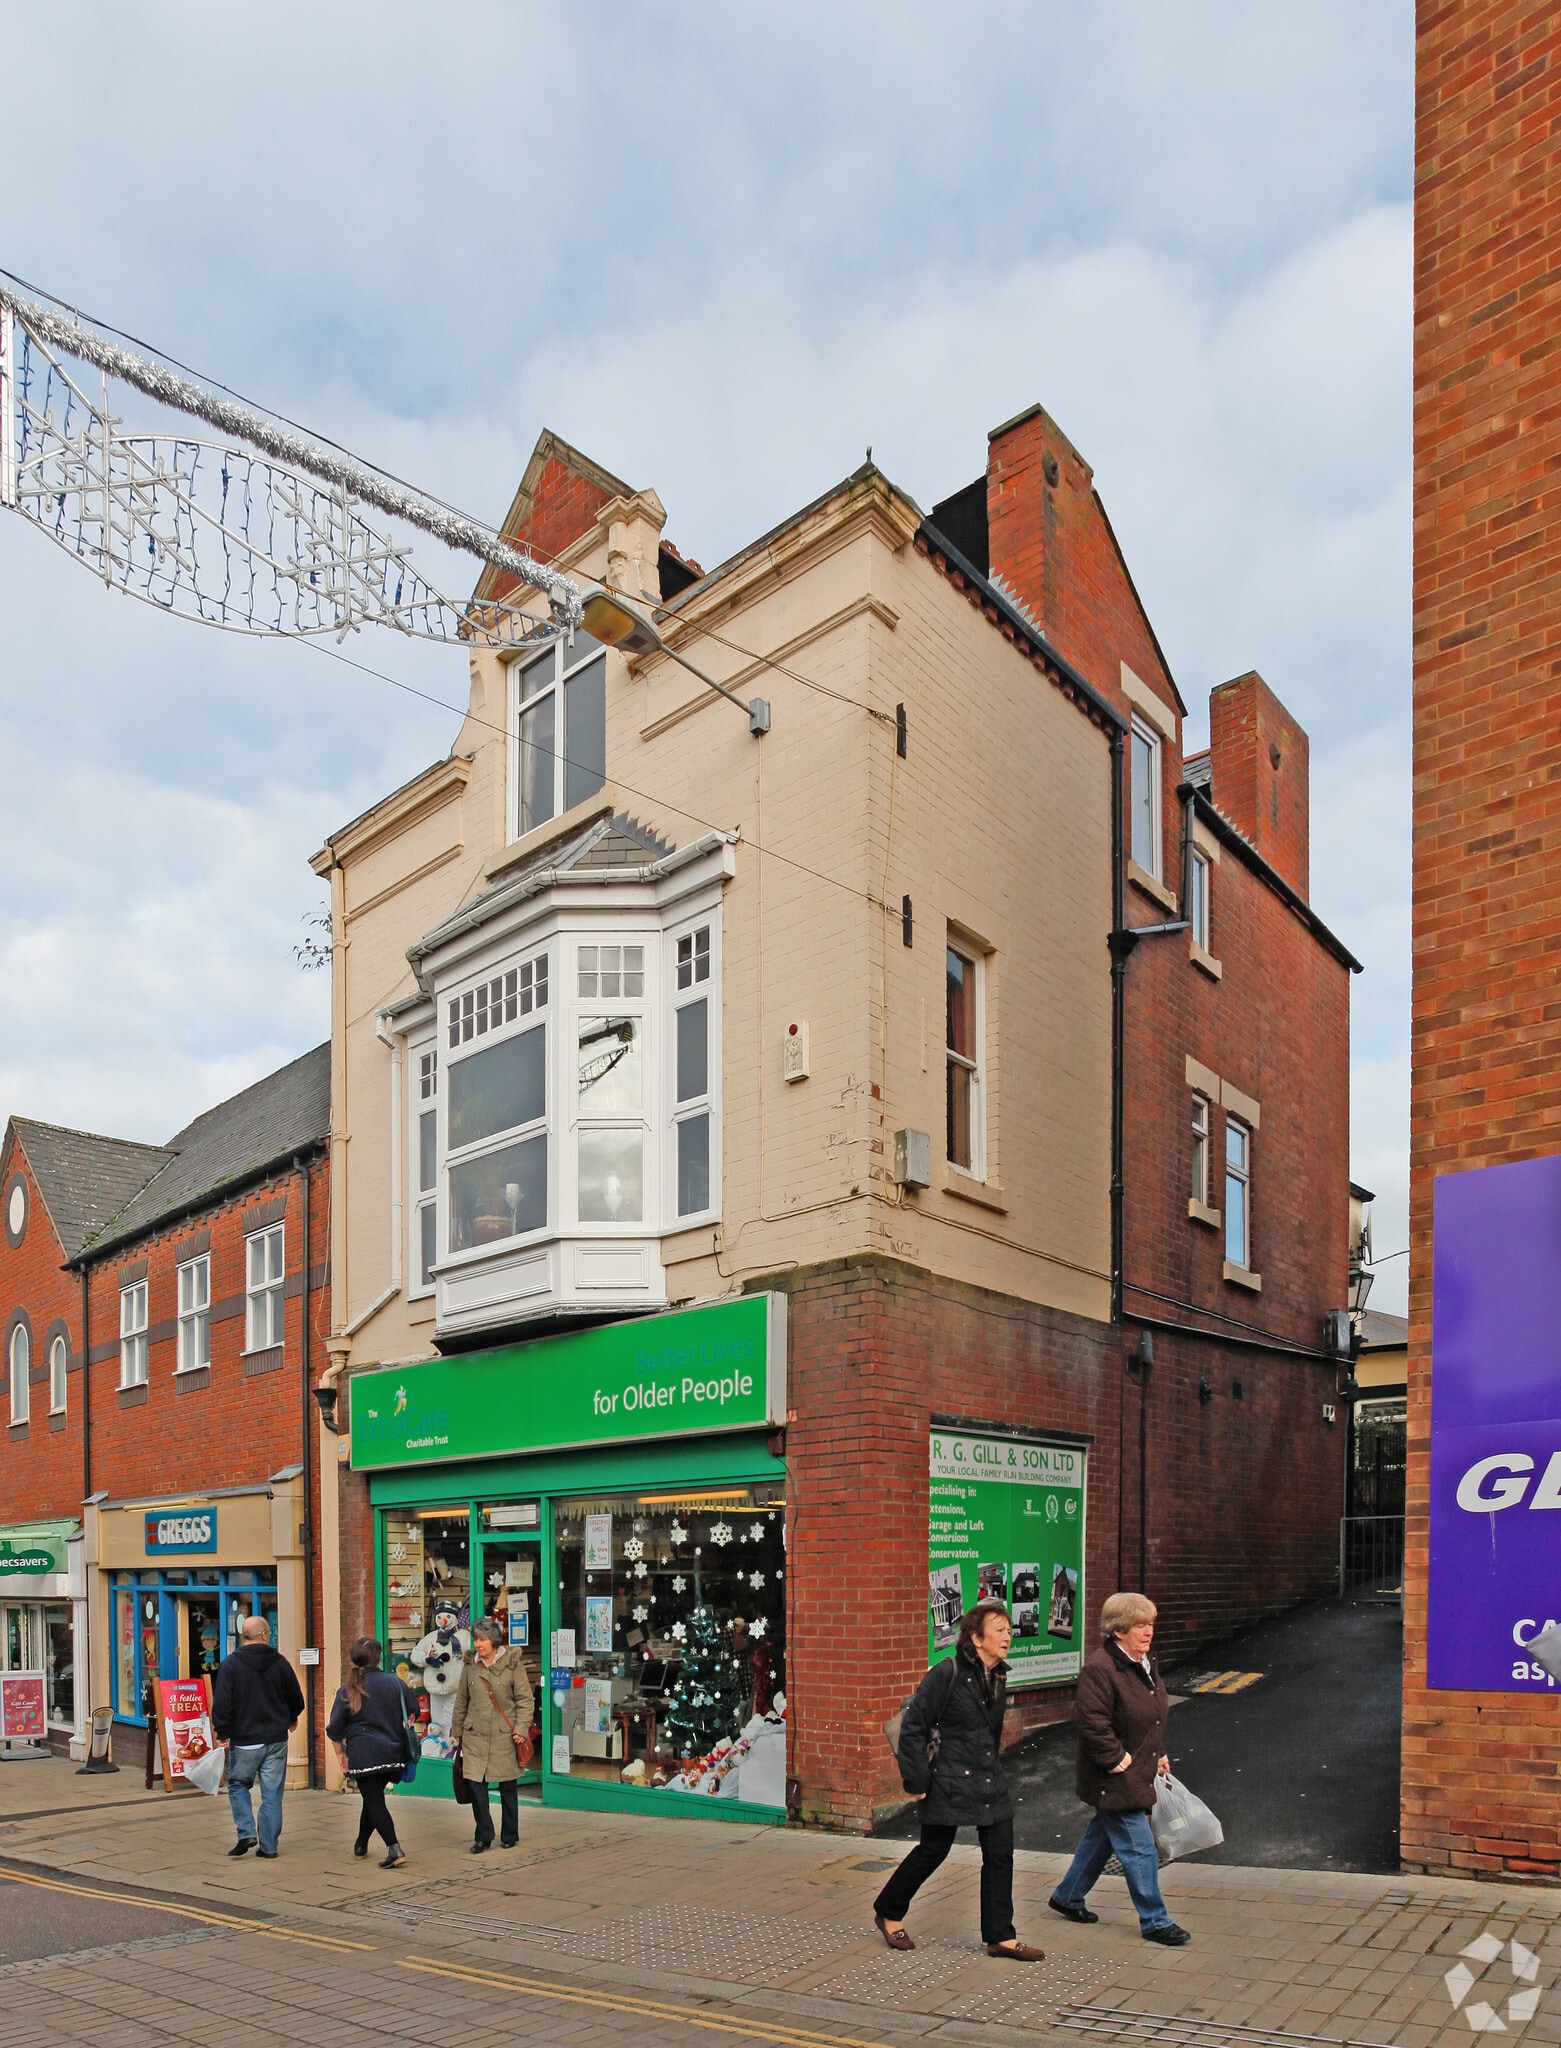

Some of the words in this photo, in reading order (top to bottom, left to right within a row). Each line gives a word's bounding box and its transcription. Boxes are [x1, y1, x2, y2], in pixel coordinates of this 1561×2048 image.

[636, 1346, 695, 1375] Better
[701, 1336, 753, 1364] Lives
[593, 1389, 619, 1415] for
[623, 1381, 676, 1411] Older
[681, 1368, 753, 1405] People
[368, 1409, 378, 1418] The
[358, 1405, 449, 1443] ExtraCare
[406, 1436, 433, 1449] Charitable
[434, 1435, 448, 1445] Trust
[933, 1439, 946, 1460] R.
[953, 1441, 967, 1462] G.
[972, 1444, 1002, 1465] GILL
[1007, 1447, 1017, 1466] &
[1022, 1449, 1049, 1471] SON
[1053, 1453, 1074, 1472] LTD
[937, 1464, 955, 1475] YOUR
[958, 1466, 979, 1477] LOCAL
[981, 1469, 1002, 1479] FAMILY
[1003, 1471, 1017, 1480] RUN
[1018, 1472, 1044, 1482] BUILDING
[1045, 1474, 1071, 1484] COMPANY
[1456, 1450, 1561, 1513] G
[929, 1484, 966, 1499] pecialising
[968, 1485, 977, 1497] in:
[929, 1503, 966, 1516] xtensions,
[157, 1515, 211, 1545] GREGGS
[954, 1519, 968, 1531] and
[969, 1519, 984, 1531] Loft
[0, 1557, 48, 1567] ecsavers
[560, 1634, 573, 1643] SALE
[169, 1702, 203, 1713] TREAT
